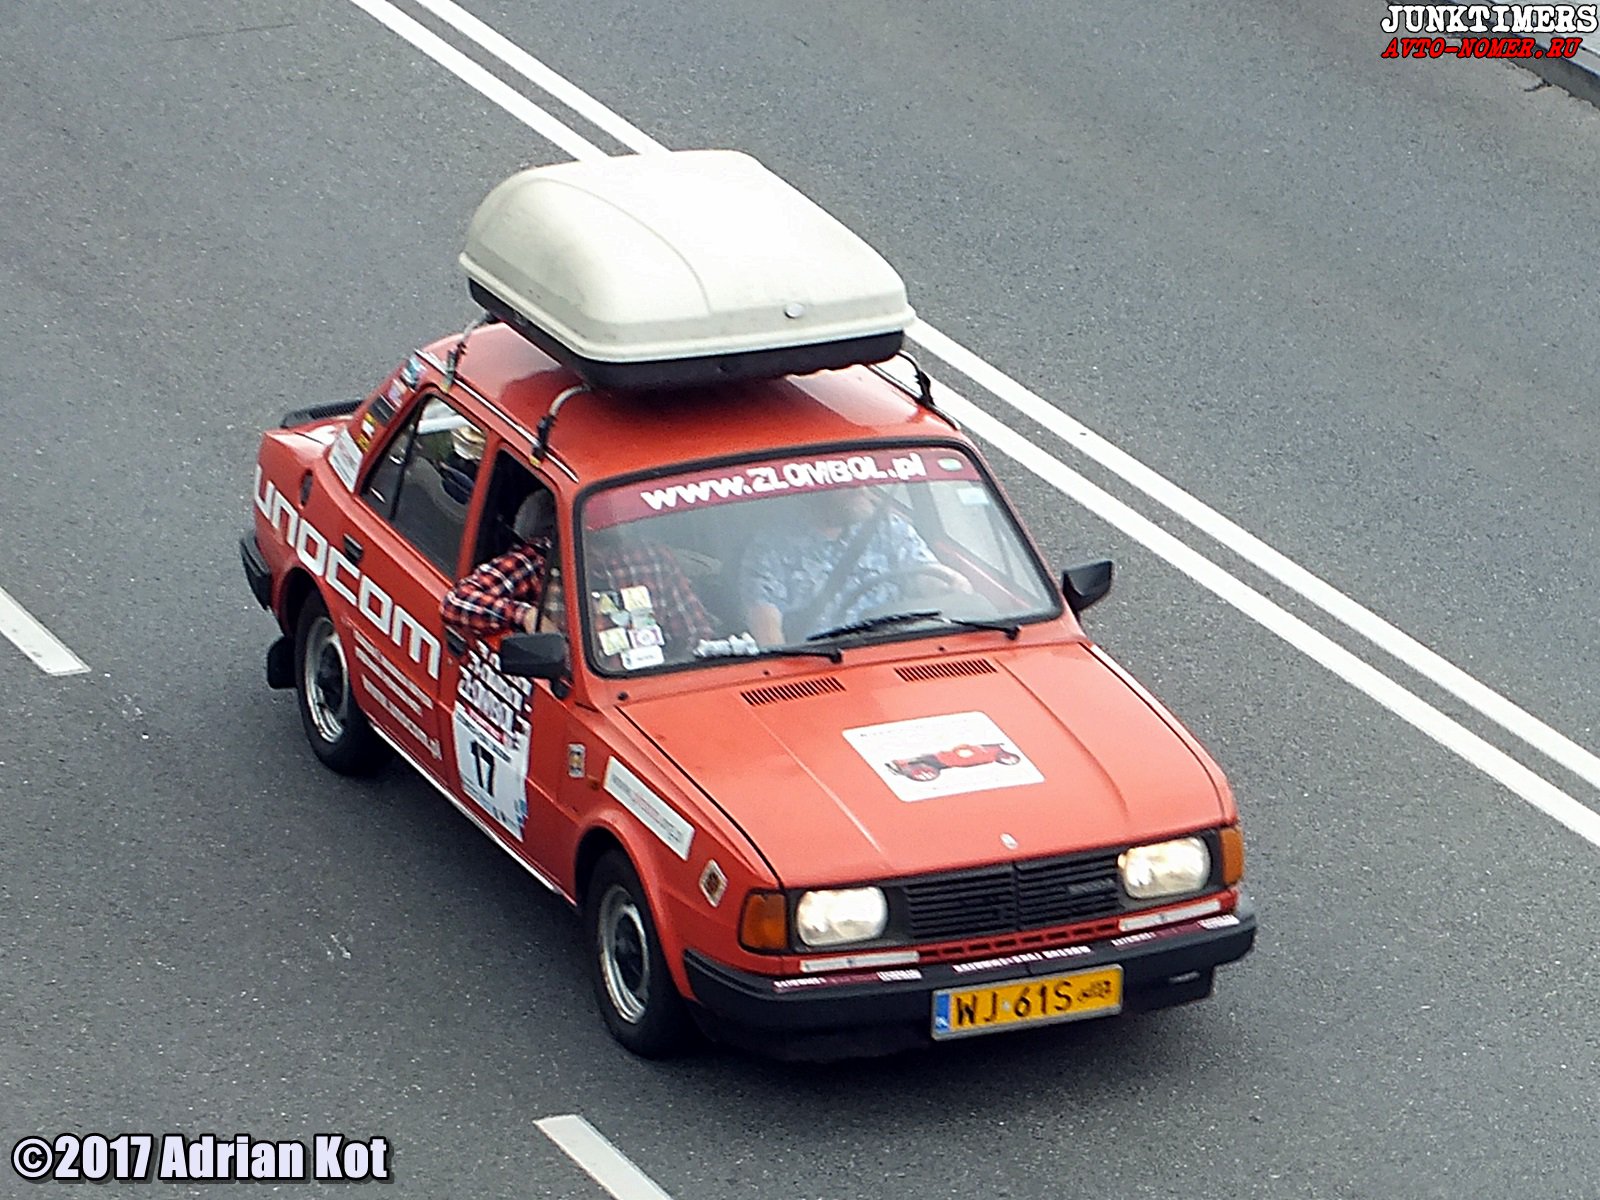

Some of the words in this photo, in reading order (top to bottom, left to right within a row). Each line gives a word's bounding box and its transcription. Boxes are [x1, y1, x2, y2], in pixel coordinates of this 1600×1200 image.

[471, 741, 495, 798] 17
[955, 990, 999, 1026] WJ
[1014, 978, 1073, 1018] 61S
